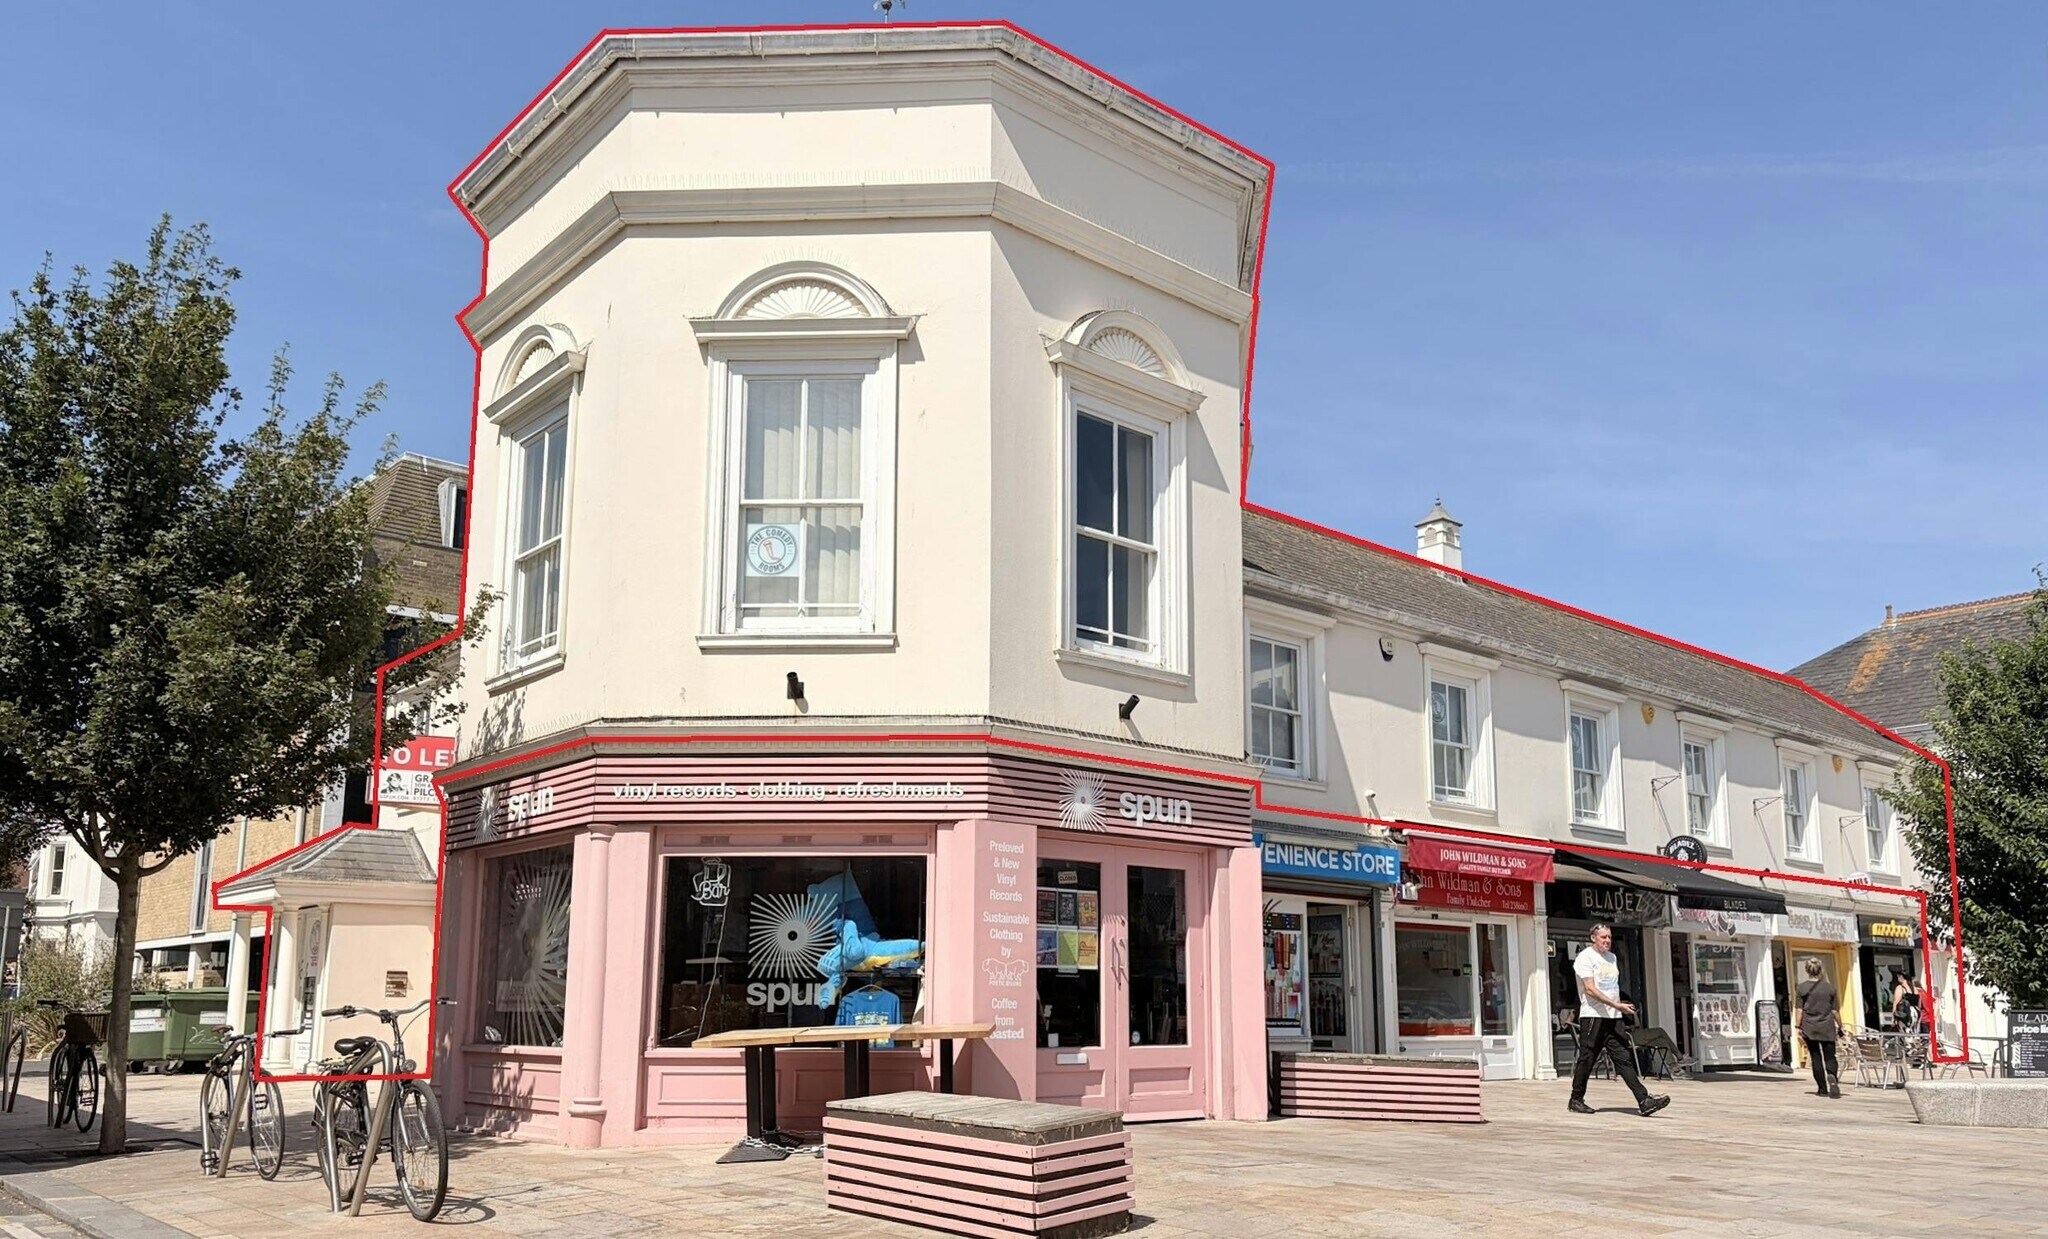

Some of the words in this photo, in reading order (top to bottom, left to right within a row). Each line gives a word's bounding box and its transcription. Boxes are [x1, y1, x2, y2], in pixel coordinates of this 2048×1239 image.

[751, 534, 764, 545] THE
[765, 529, 793, 545] COMEDY
[758, 562, 785, 572] ROOMS
[413, 788, 434, 796] PILC
[613, 783, 657, 801] vinyl
[663, 783, 737, 799] records
[747, 781, 826, 801] clothing
[836, 781, 964, 798] refreshments
[508, 786, 554, 823] spun
[1119, 792, 1192, 827] spun
[989, 840, 1024, 854] Preloved
[993, 857, 1000, 868] &
[1001, 857, 1020, 869] New
[1342, 851, 1396, 876] STORE
[1440, 849, 1460, 863] JOHN
[1461, 851, 1499, 866] WILDMAN
[1500, 856, 1507, 865] &
[1507, 857, 1527, 868] SONS
[996, 873, 1017, 887] Vinyl
[1437, 871, 1480, 893] Wildman
[1496, 878, 1522, 897] Sons
[989, 889, 1023, 902] Records
[1583, 888, 1643, 913] BLADEZ
[983, 911, 1030, 925] Sustainable
[989, 928, 1023, 943] Clothing
[1001, 945, 1012, 958] by
[991, 998, 1018, 1009] Coffee
[994, 1014, 1015, 1026] from
[2017, 1013, 2048, 1024] BLAD
[2012, 1024, 2040, 1035] price
